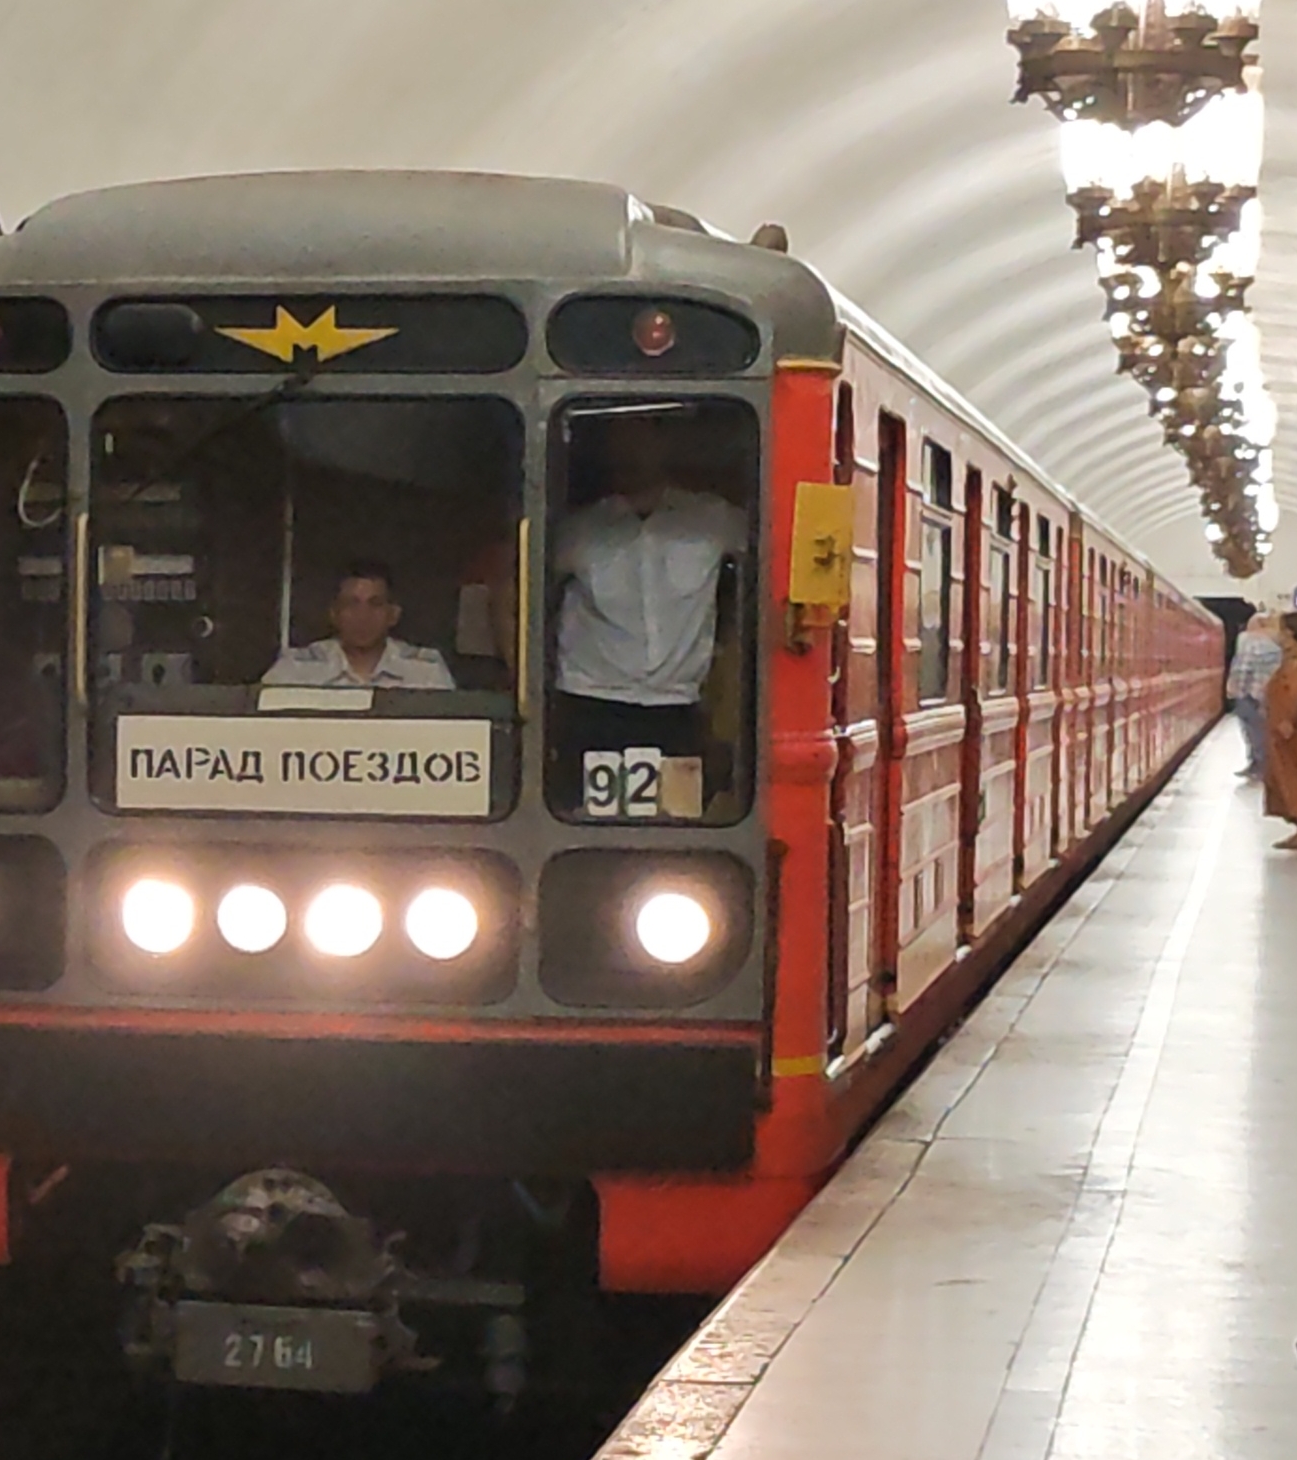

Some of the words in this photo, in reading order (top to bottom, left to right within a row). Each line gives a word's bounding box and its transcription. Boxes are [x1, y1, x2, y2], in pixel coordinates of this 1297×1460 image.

[129, 747, 264, 784] ПАРАД
[281, 749, 482, 785] ПОЕЗДОВ
[587, 760, 659, 808] 92
[223, 1332, 314, 1370] 2764
